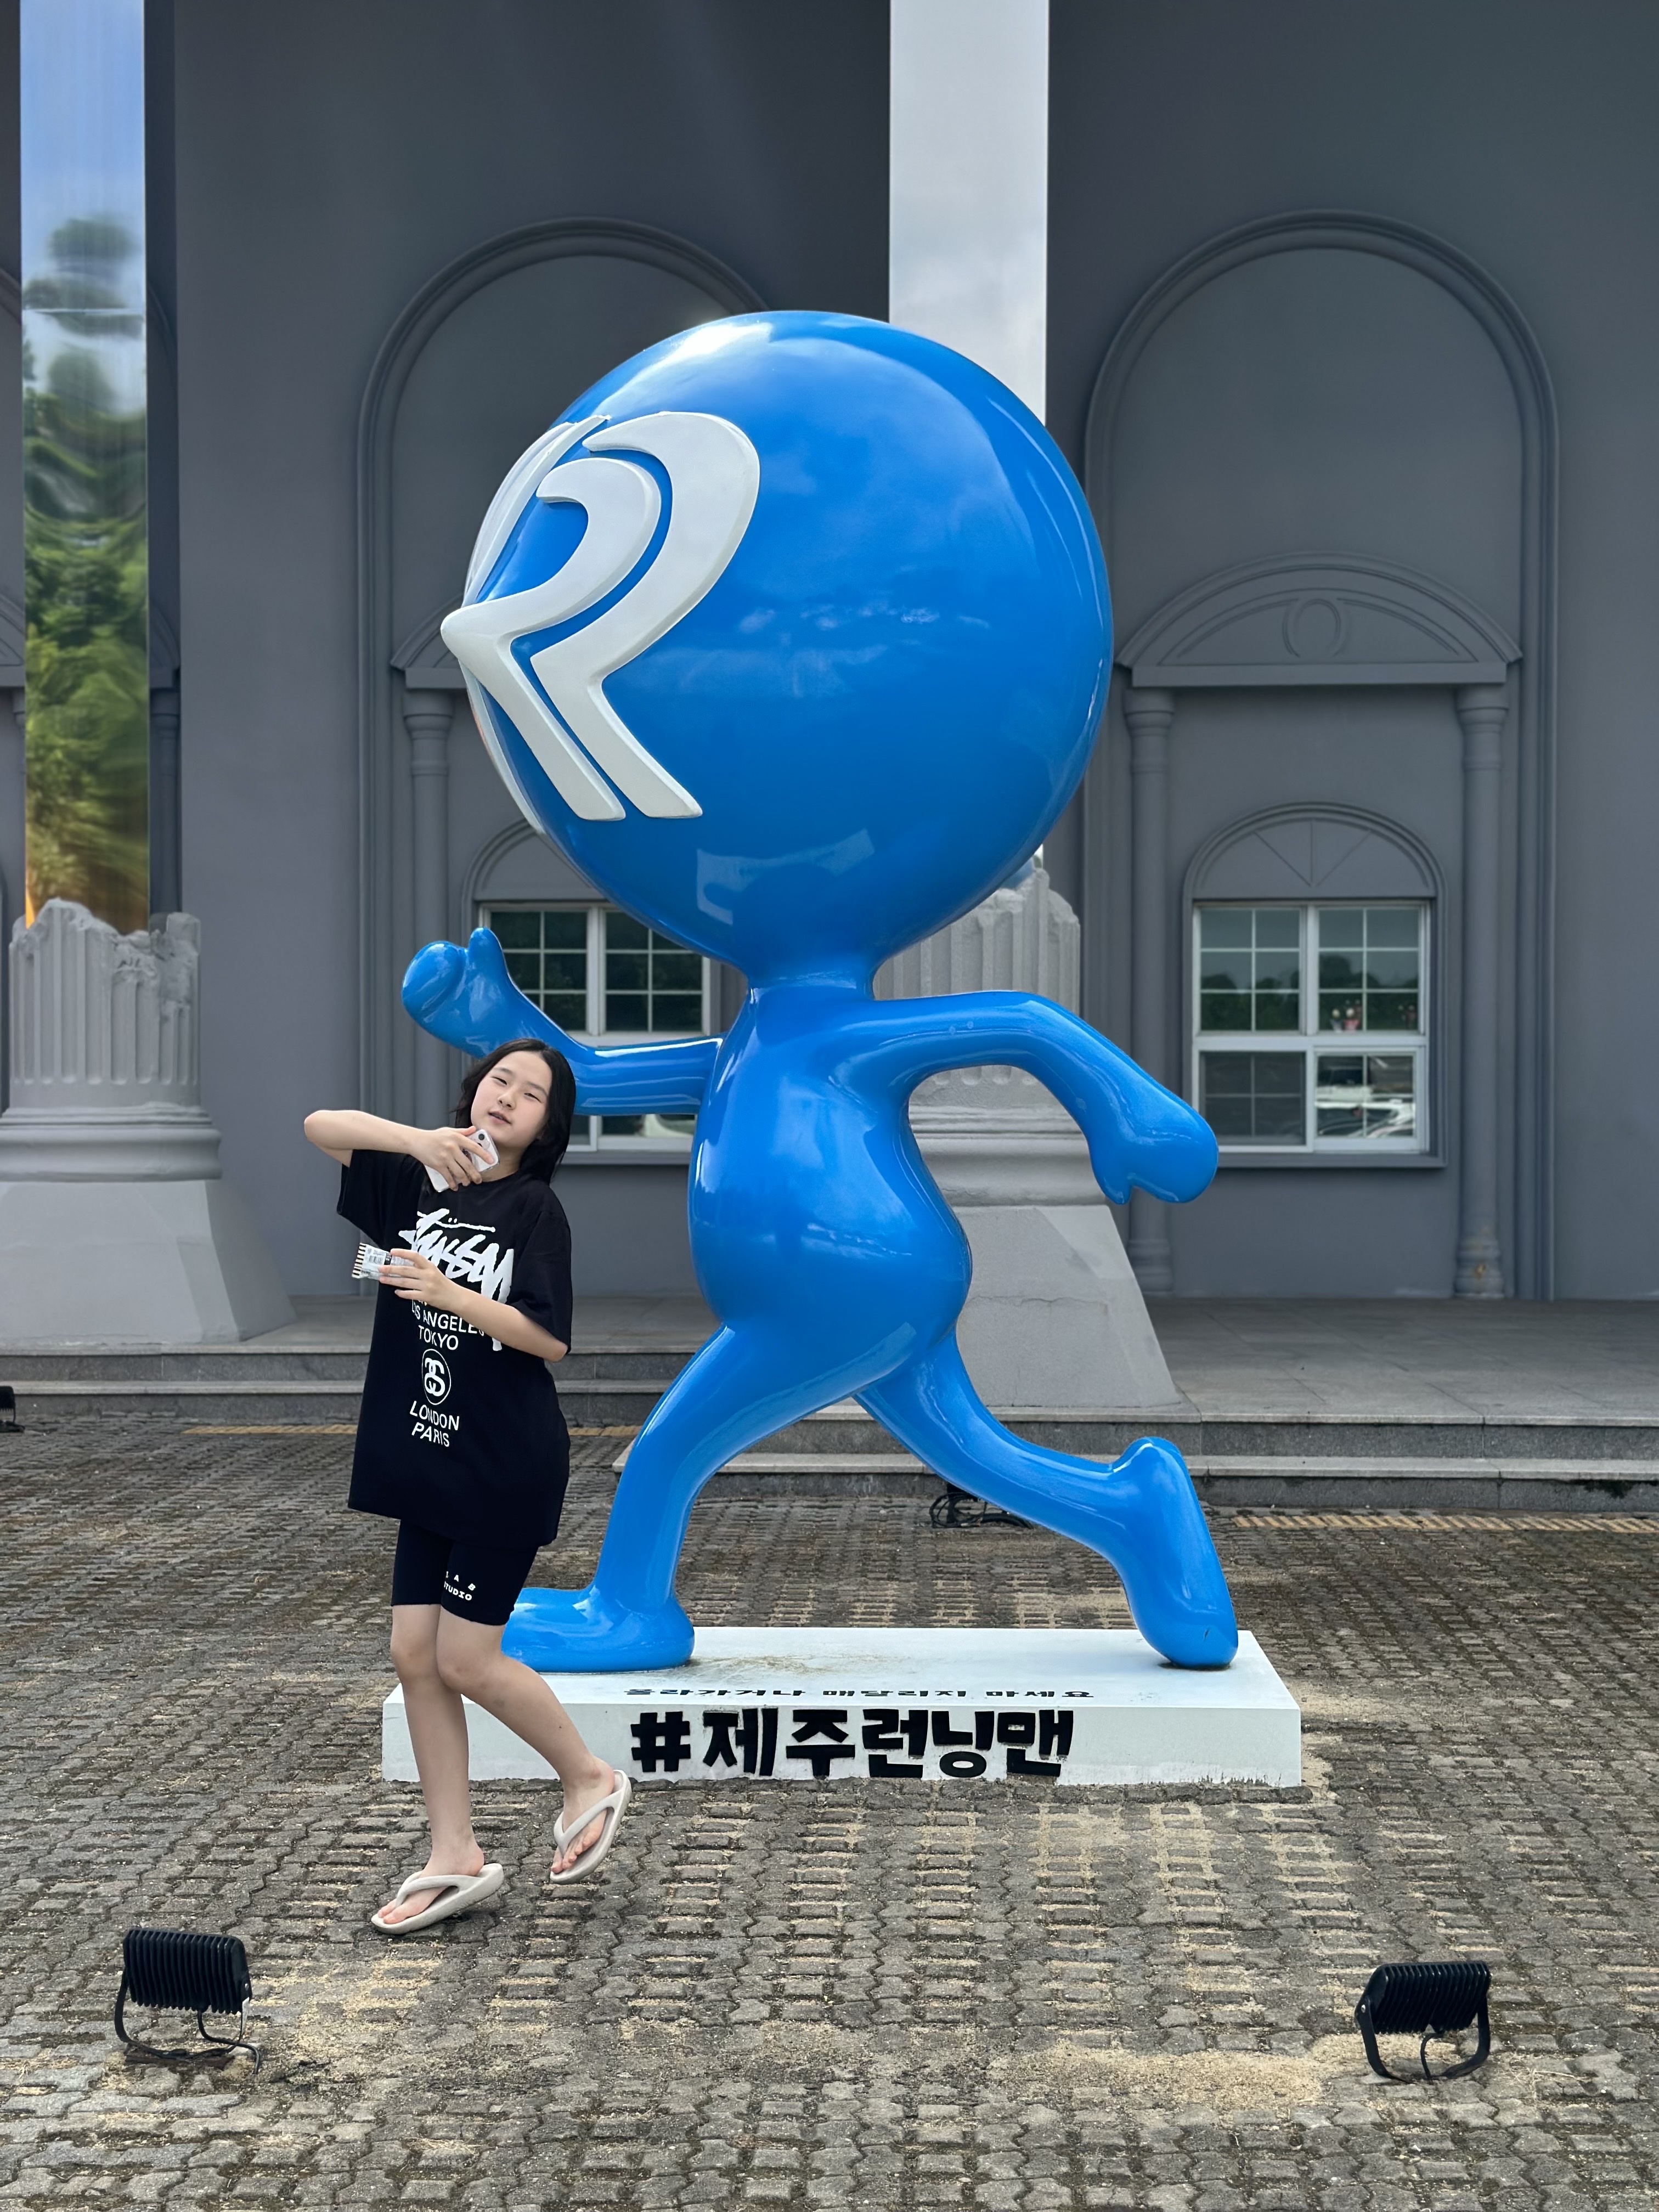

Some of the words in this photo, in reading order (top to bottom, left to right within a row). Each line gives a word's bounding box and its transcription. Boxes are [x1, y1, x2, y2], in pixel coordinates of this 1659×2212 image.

[418, 1325, 459, 1351] TOKYO
[409, 1401, 460, 1431] LONDON
[411, 1422, 450, 1447] PARIS
[443, 1581, 472, 1601] TUDIO
[630, 1707, 1074, 1779] #제주런닝맨
